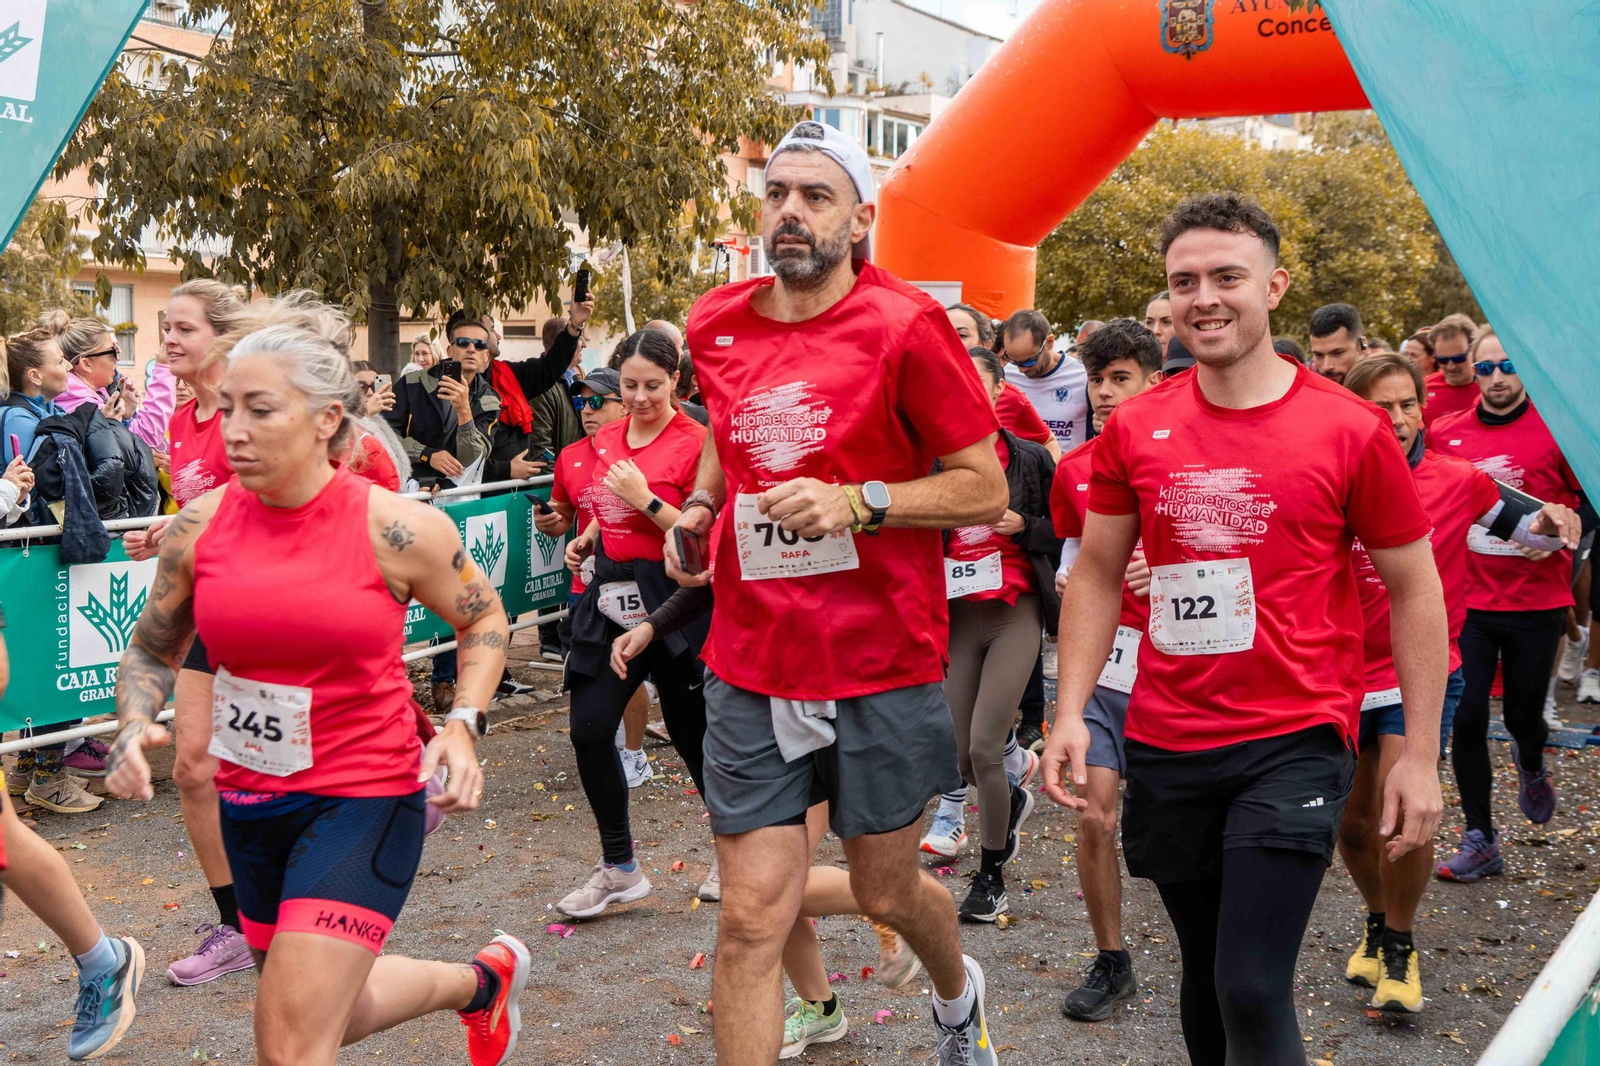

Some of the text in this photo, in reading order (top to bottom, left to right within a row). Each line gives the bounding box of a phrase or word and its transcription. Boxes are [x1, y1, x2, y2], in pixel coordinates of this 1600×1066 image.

[1257, 17, 1333, 37] Conce
[731, 427, 826, 443] HUMANIDAD
[1250, 500, 1271, 518] de
[1157, 501, 1268, 535] HUMANIDAD
[781, 550, 811, 559] RAFA
[952, 563, 976, 578] 85
[524, 578, 542, 593] CAJA
[531, 588, 556, 602] GRANADA
[404, 607, 426, 624] RAL
[622, 612, 649, 620] CARME
[1171, 595, 1217, 620] 122
[55, 570, 68, 670] fundación
[56, 666, 119, 691] CAJA R
[79, 685, 117, 702] GRAN
[228, 703, 283, 742] 245
